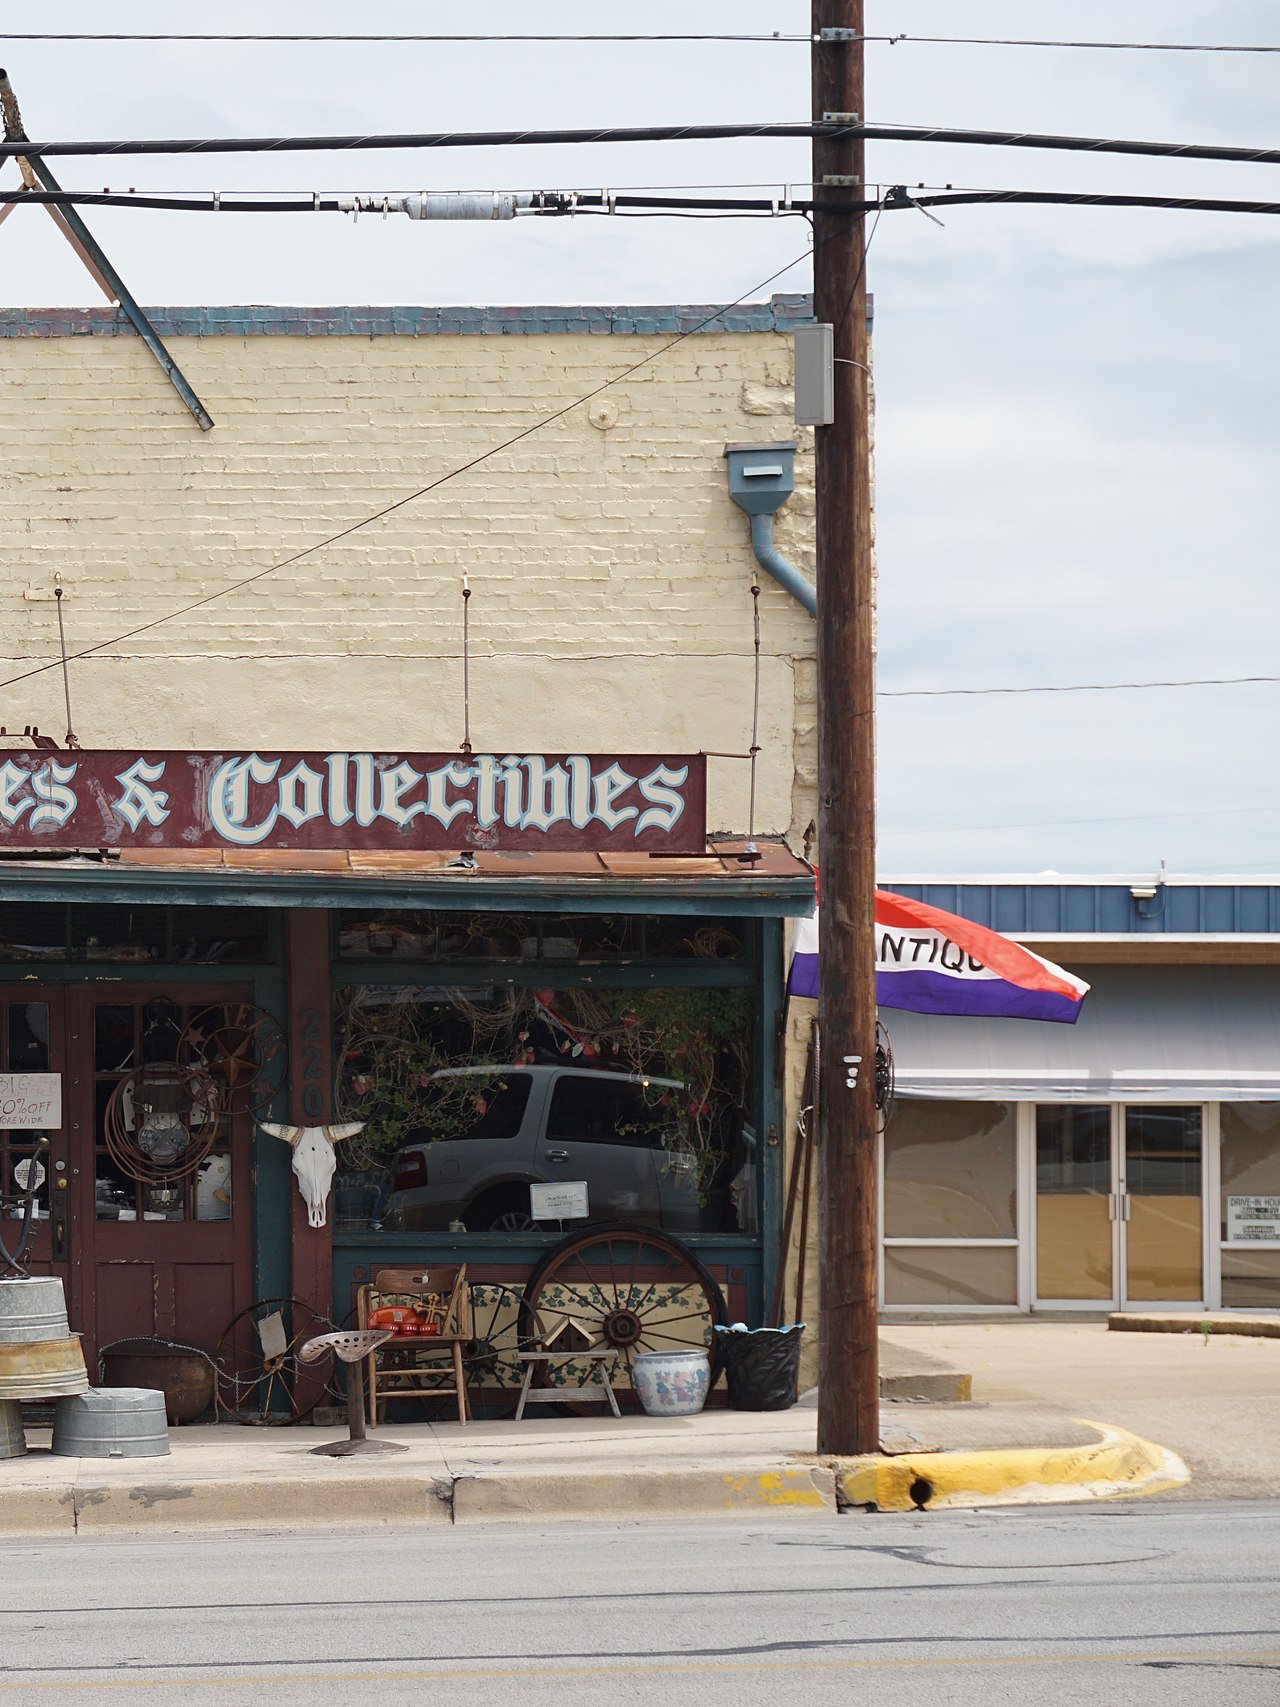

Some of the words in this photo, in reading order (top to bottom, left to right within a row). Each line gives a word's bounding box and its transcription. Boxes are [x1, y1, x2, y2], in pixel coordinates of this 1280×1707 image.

[114, 756, 169, 833] &
[207, 751, 690, 845] Collectibles
[876, 932, 987, 974] NTIQU
[302, 1008, 324, 1117] 220
